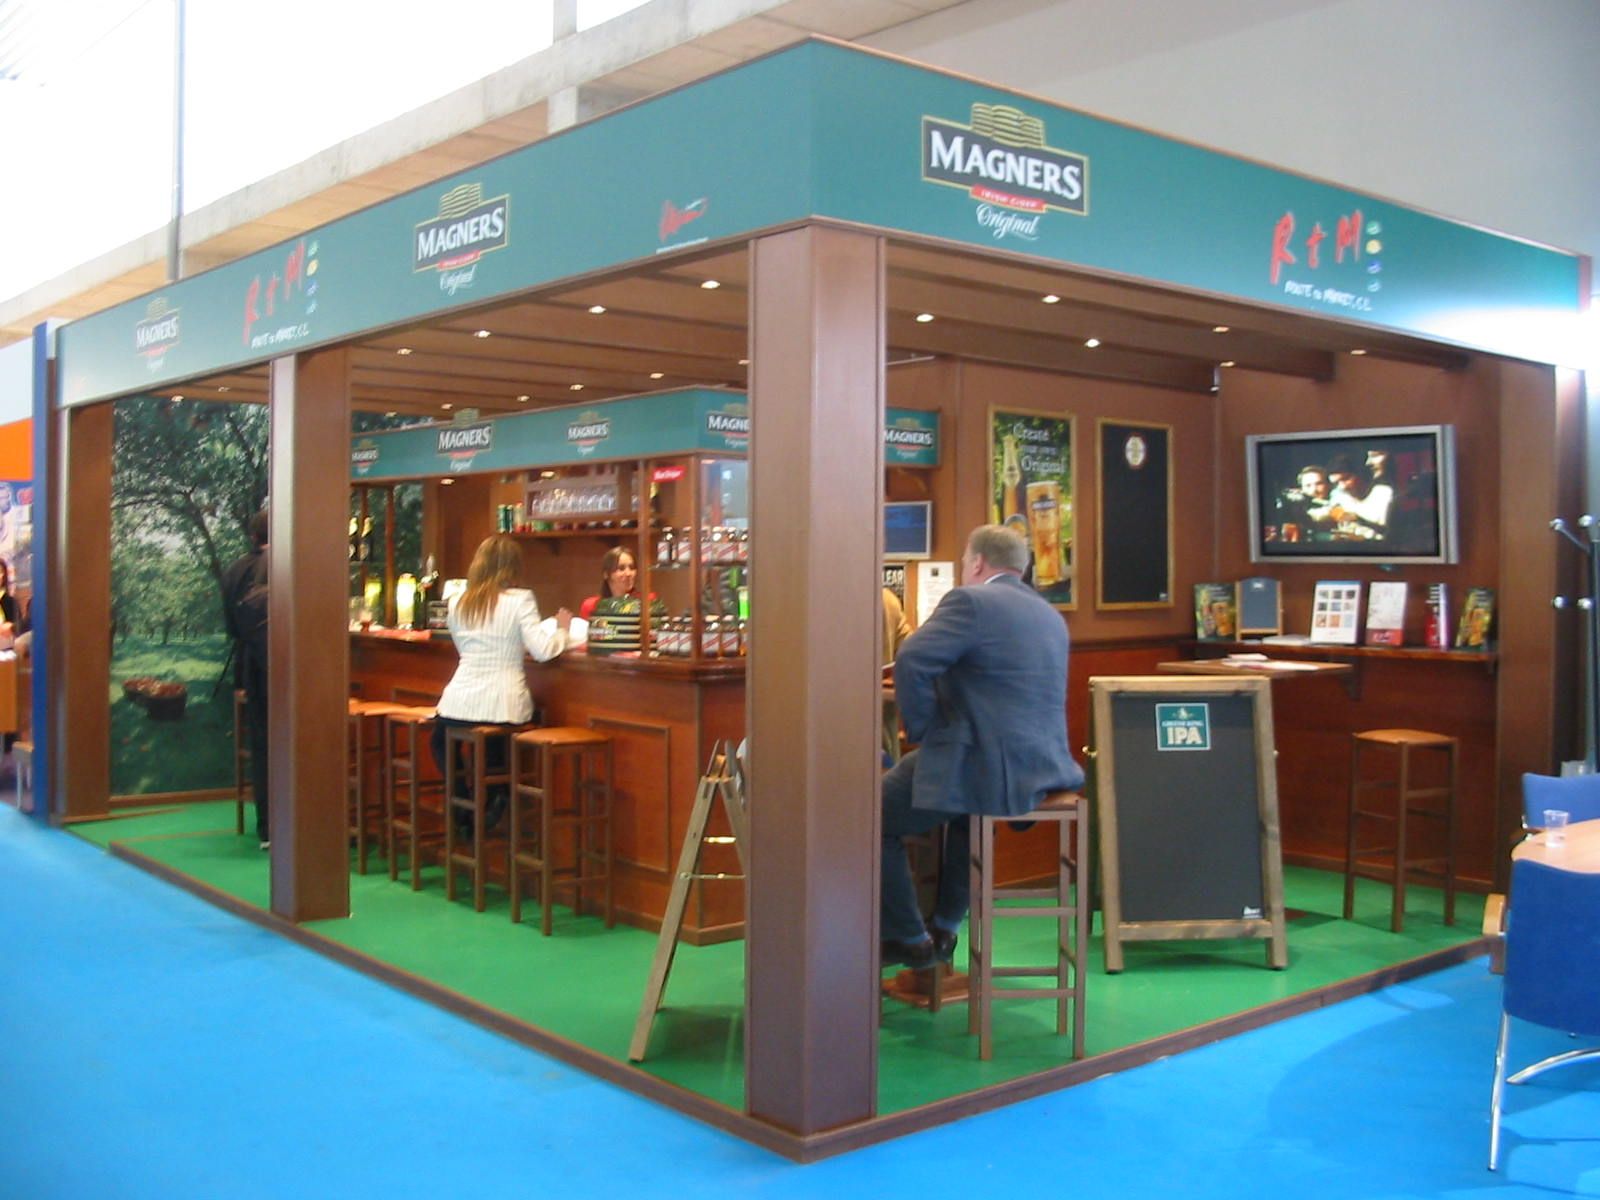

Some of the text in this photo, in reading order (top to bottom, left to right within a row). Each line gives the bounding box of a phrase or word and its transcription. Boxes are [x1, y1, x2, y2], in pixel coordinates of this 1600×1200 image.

[930, 130, 1082, 200] MAGNERS
[417, 206, 504, 261] MAGNERS
[975, 203, 1041, 240] Original
[136, 316, 177, 352] MAGNERS
[438, 426, 491, 450] MAGNERS
[568, 422, 609, 440] MAGNERS
[708, 415, 750, 432] MAGNE
[1167, 726, 1203, 745] IPA
